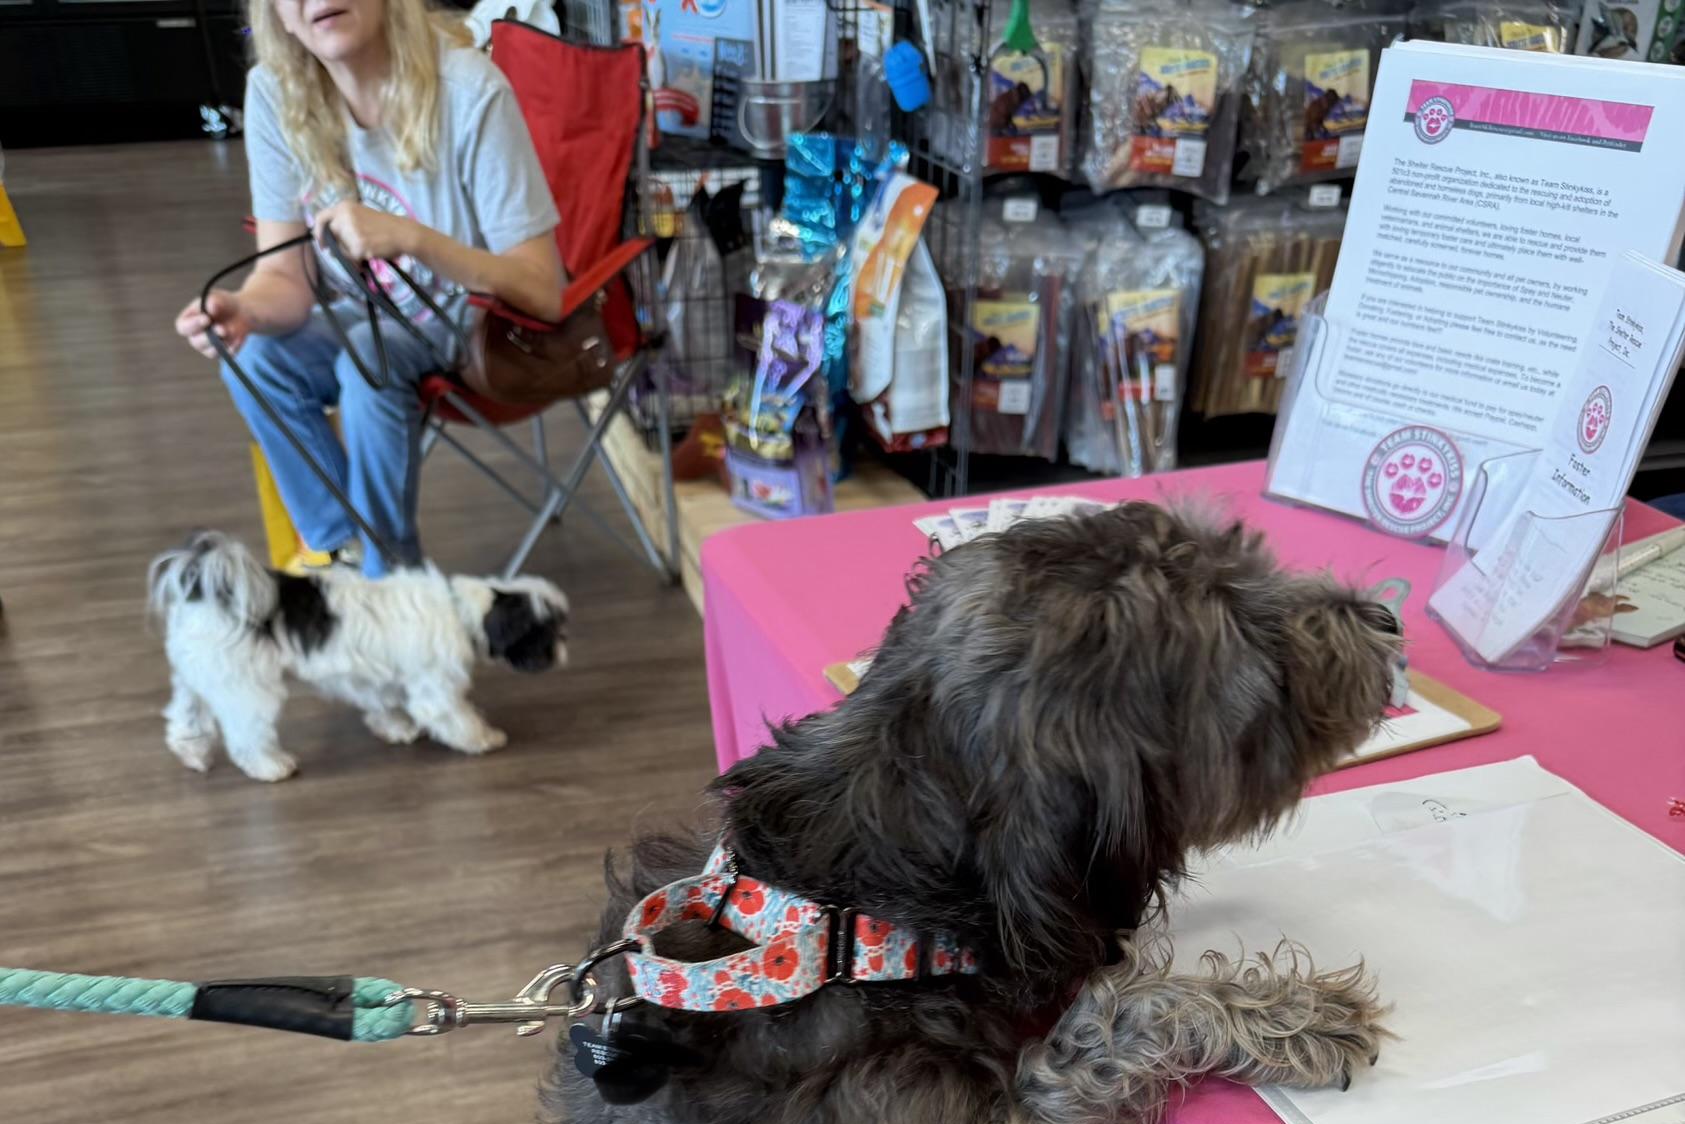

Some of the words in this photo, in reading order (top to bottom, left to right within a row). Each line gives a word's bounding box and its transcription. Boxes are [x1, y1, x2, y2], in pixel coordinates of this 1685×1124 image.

[1391, 167, 1411, 176] 501c3
[1410, 170, 1441, 181] non-profit
[1440, 174, 1479, 187] organization
[1479, 180, 1511, 191] dedicated
[1510, 184, 1518, 192] to
[1518, 185, 1530, 193] the
[1529, 187, 1559, 199] rescuing
[1558, 191, 1573, 200] and
[1572, 193, 1603, 205] adoption
[1393, 157, 1407, 165] The
[1406, 159, 1429, 169] Shelter
[1429, 162, 1454, 172] Rescue
[1492, 172, 1508, 180] also
[1507, 174, 1530, 183] known
[1539, 178, 1560, 188] Team
[1595, 186, 1604, 194] is
[1389, 176, 1423, 188] abandoned
[1423, 182, 1436, 190] and
[1436, 184, 1467, 194] homeless
[1484, 191, 1513, 202] primarily
[1512, 195, 1529, 204] from
[1528, 197, 1545, 206] local
[1544, 200, 1571, 211] high-kill
[1571, 204, 1599, 214] shelters
[1598, 208, 1607, 216] in
[1606, 209, 1619, 217] the
[1380, 428, 1411, 452] TEAM
[1568, 453, 1591, 477] Foster
[1552, 468, 1591, 505] Information
